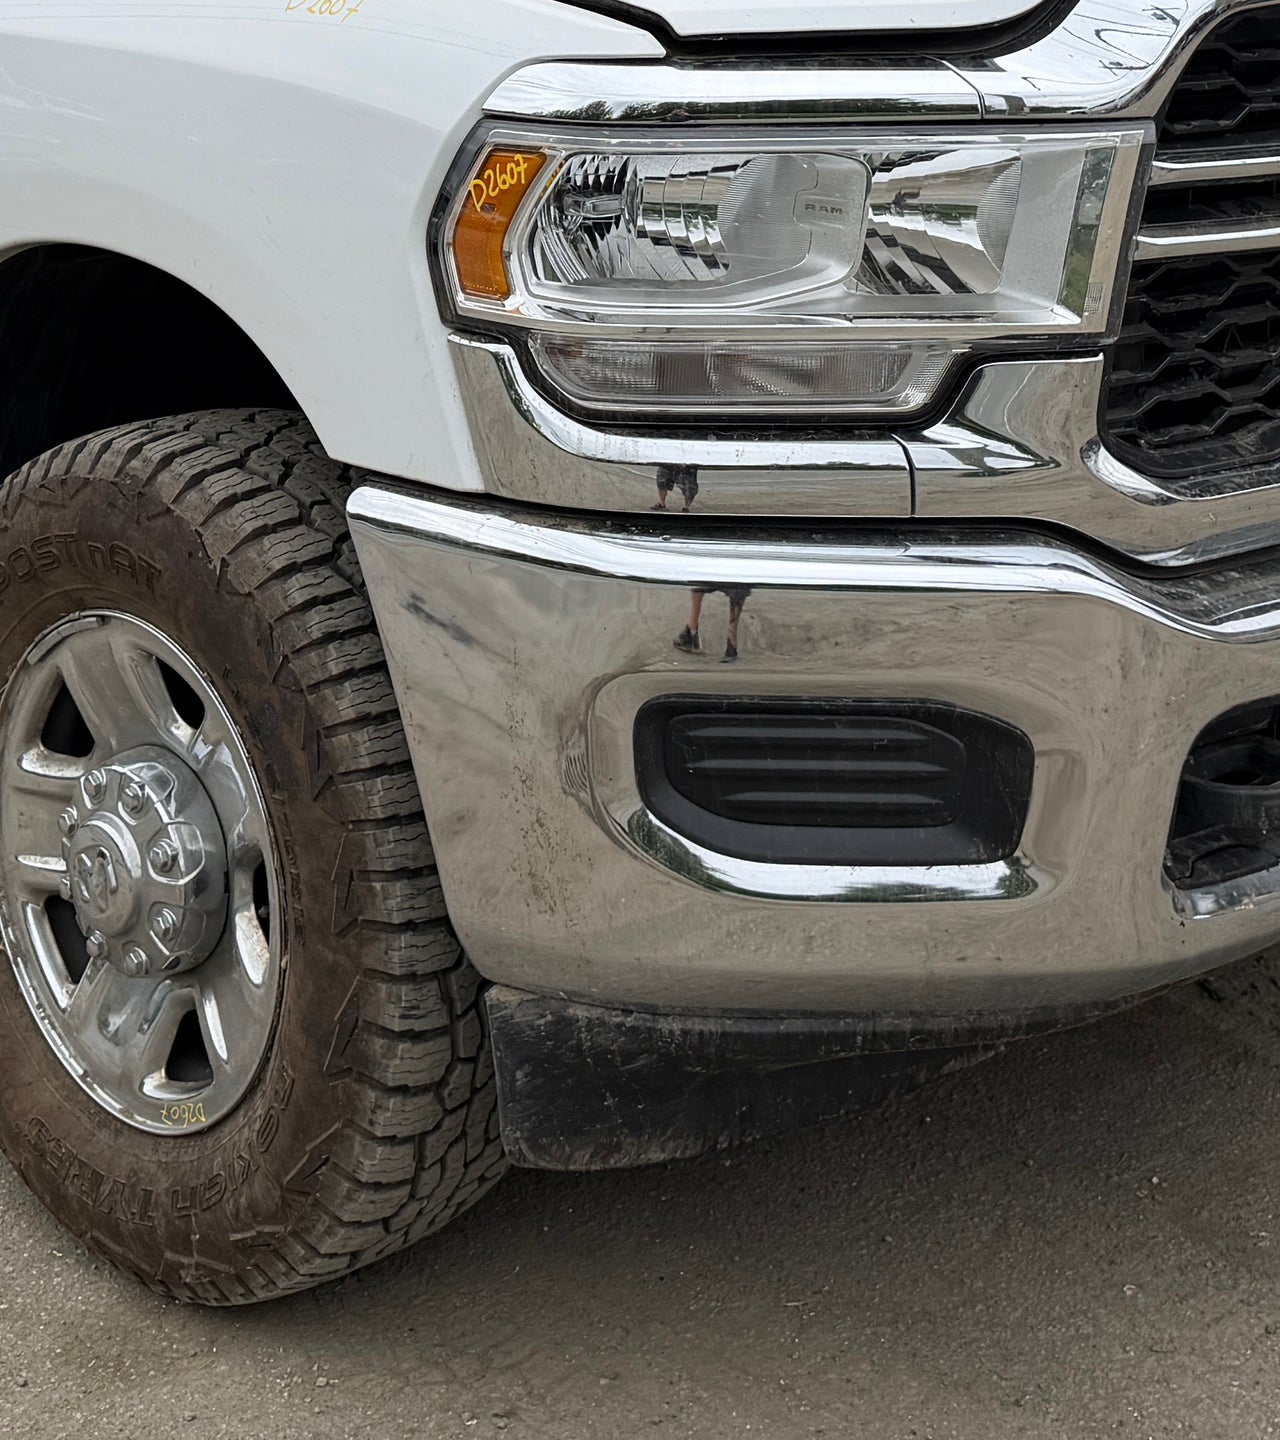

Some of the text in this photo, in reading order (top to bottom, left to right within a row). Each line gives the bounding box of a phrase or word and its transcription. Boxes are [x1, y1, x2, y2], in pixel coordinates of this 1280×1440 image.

[469, 154, 528, 212] D2607
[805, 203, 843, 215] RAM
[160, 1102, 206, 1128] D2607
